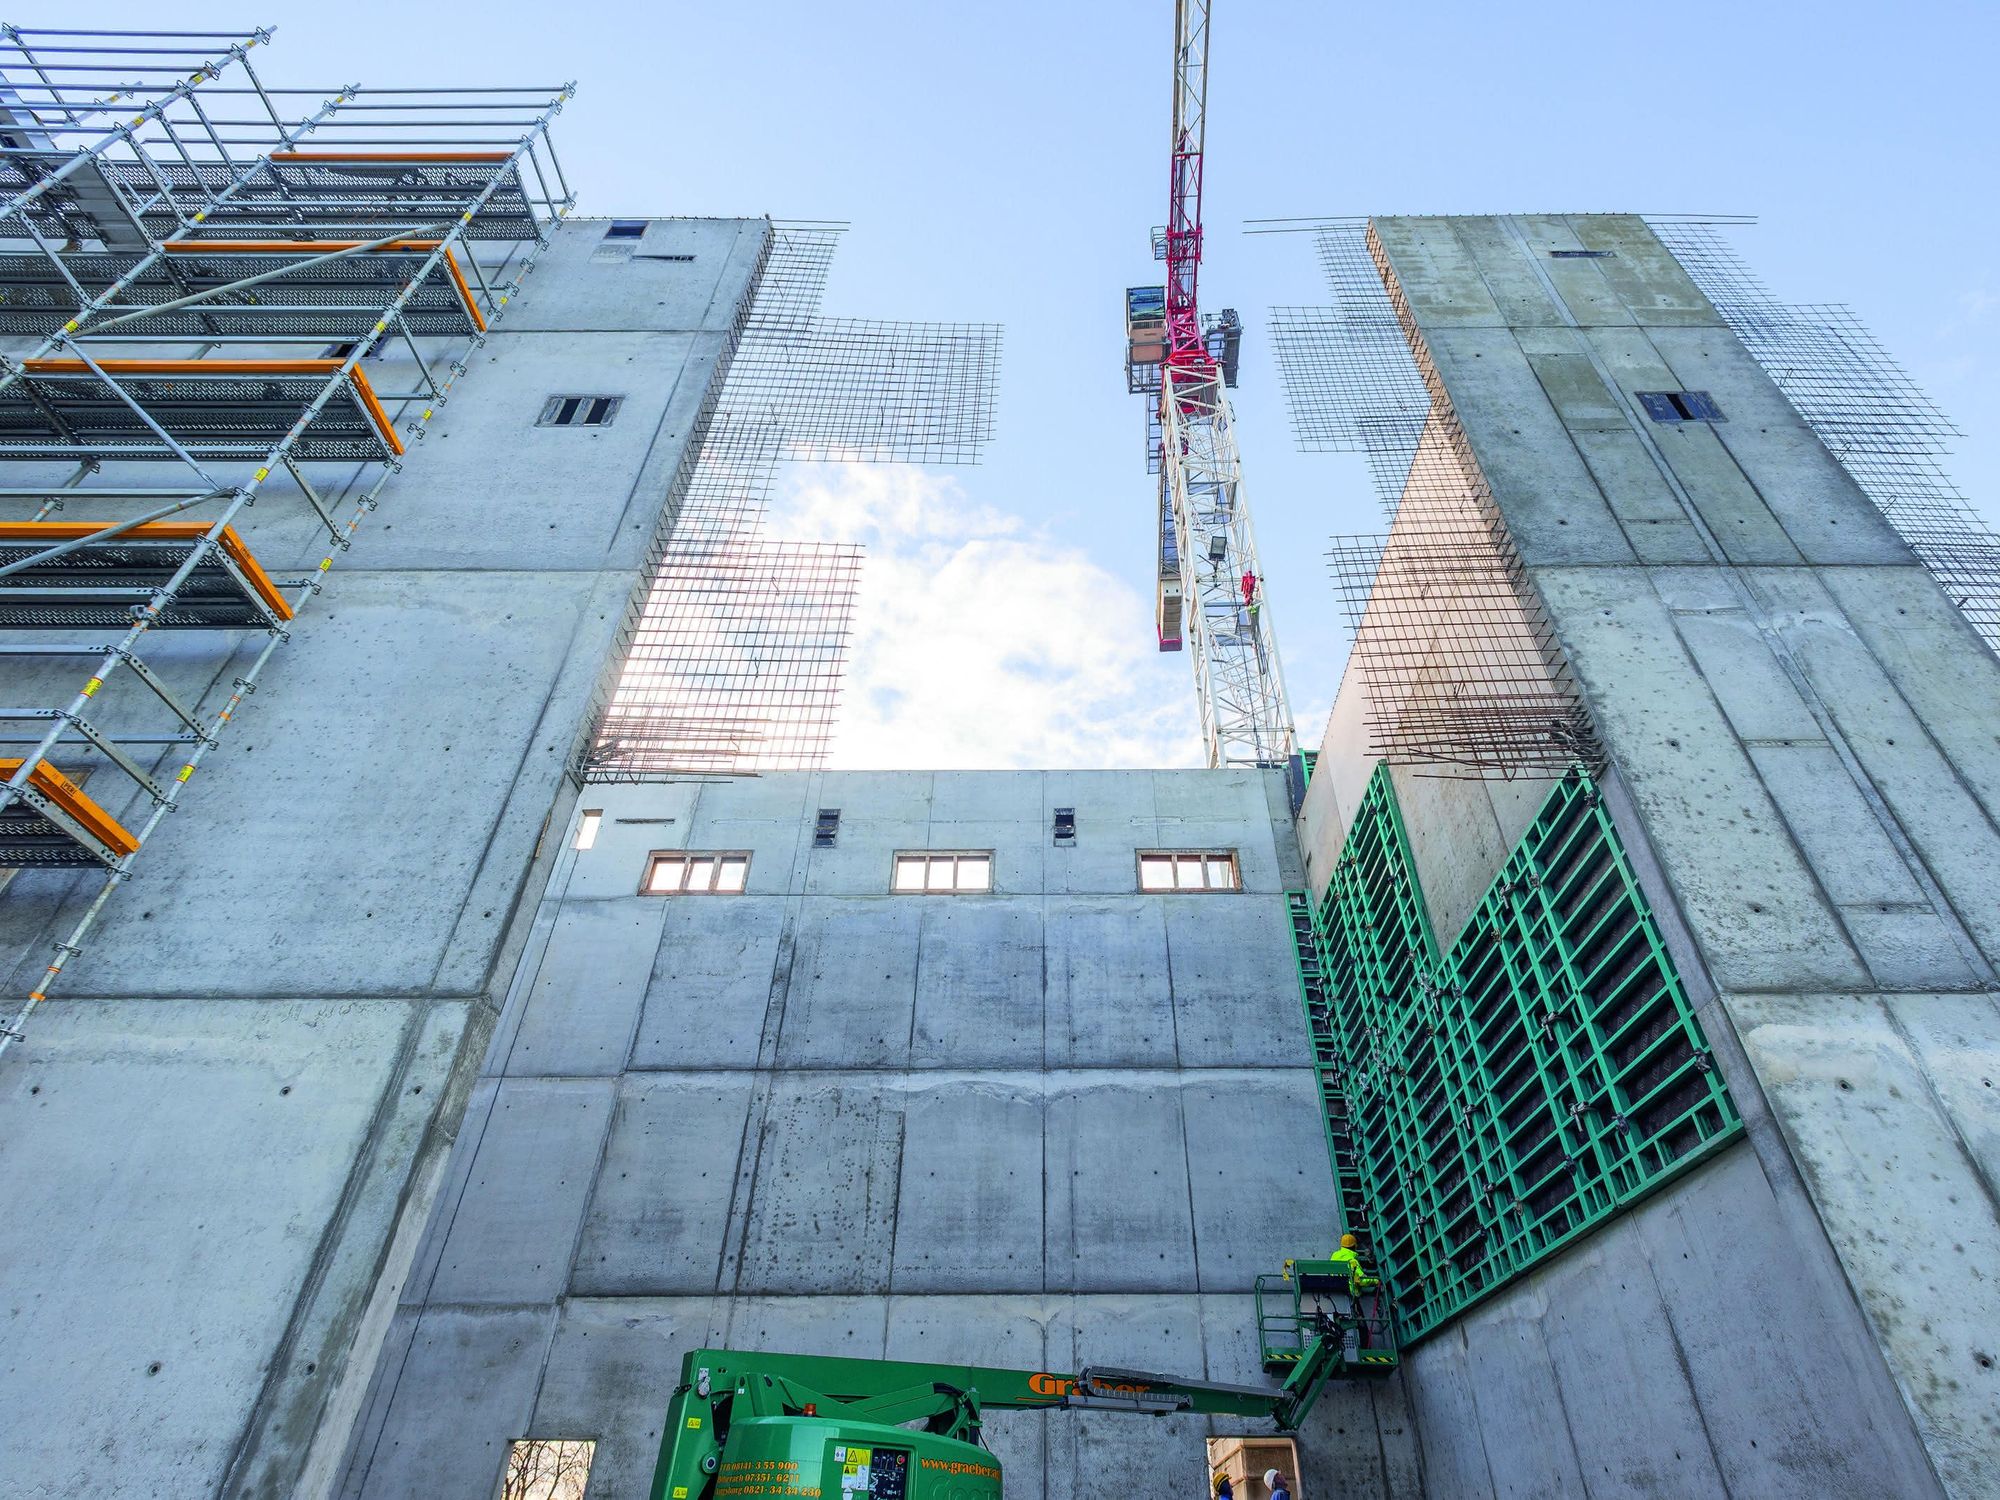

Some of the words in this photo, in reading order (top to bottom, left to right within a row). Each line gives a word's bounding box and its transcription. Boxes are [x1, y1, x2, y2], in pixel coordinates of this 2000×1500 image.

[755, 1461, 761, 1470] 3
[763, 1461, 775, 1470] 55
[777, 1461, 798, 1470] 900
[776, 1473, 801, 1484] 6211
[769, 1485, 783, 1495] 34
[784, 1486, 799, 1496] 34
[801, 1487, 822, 1497] 230
